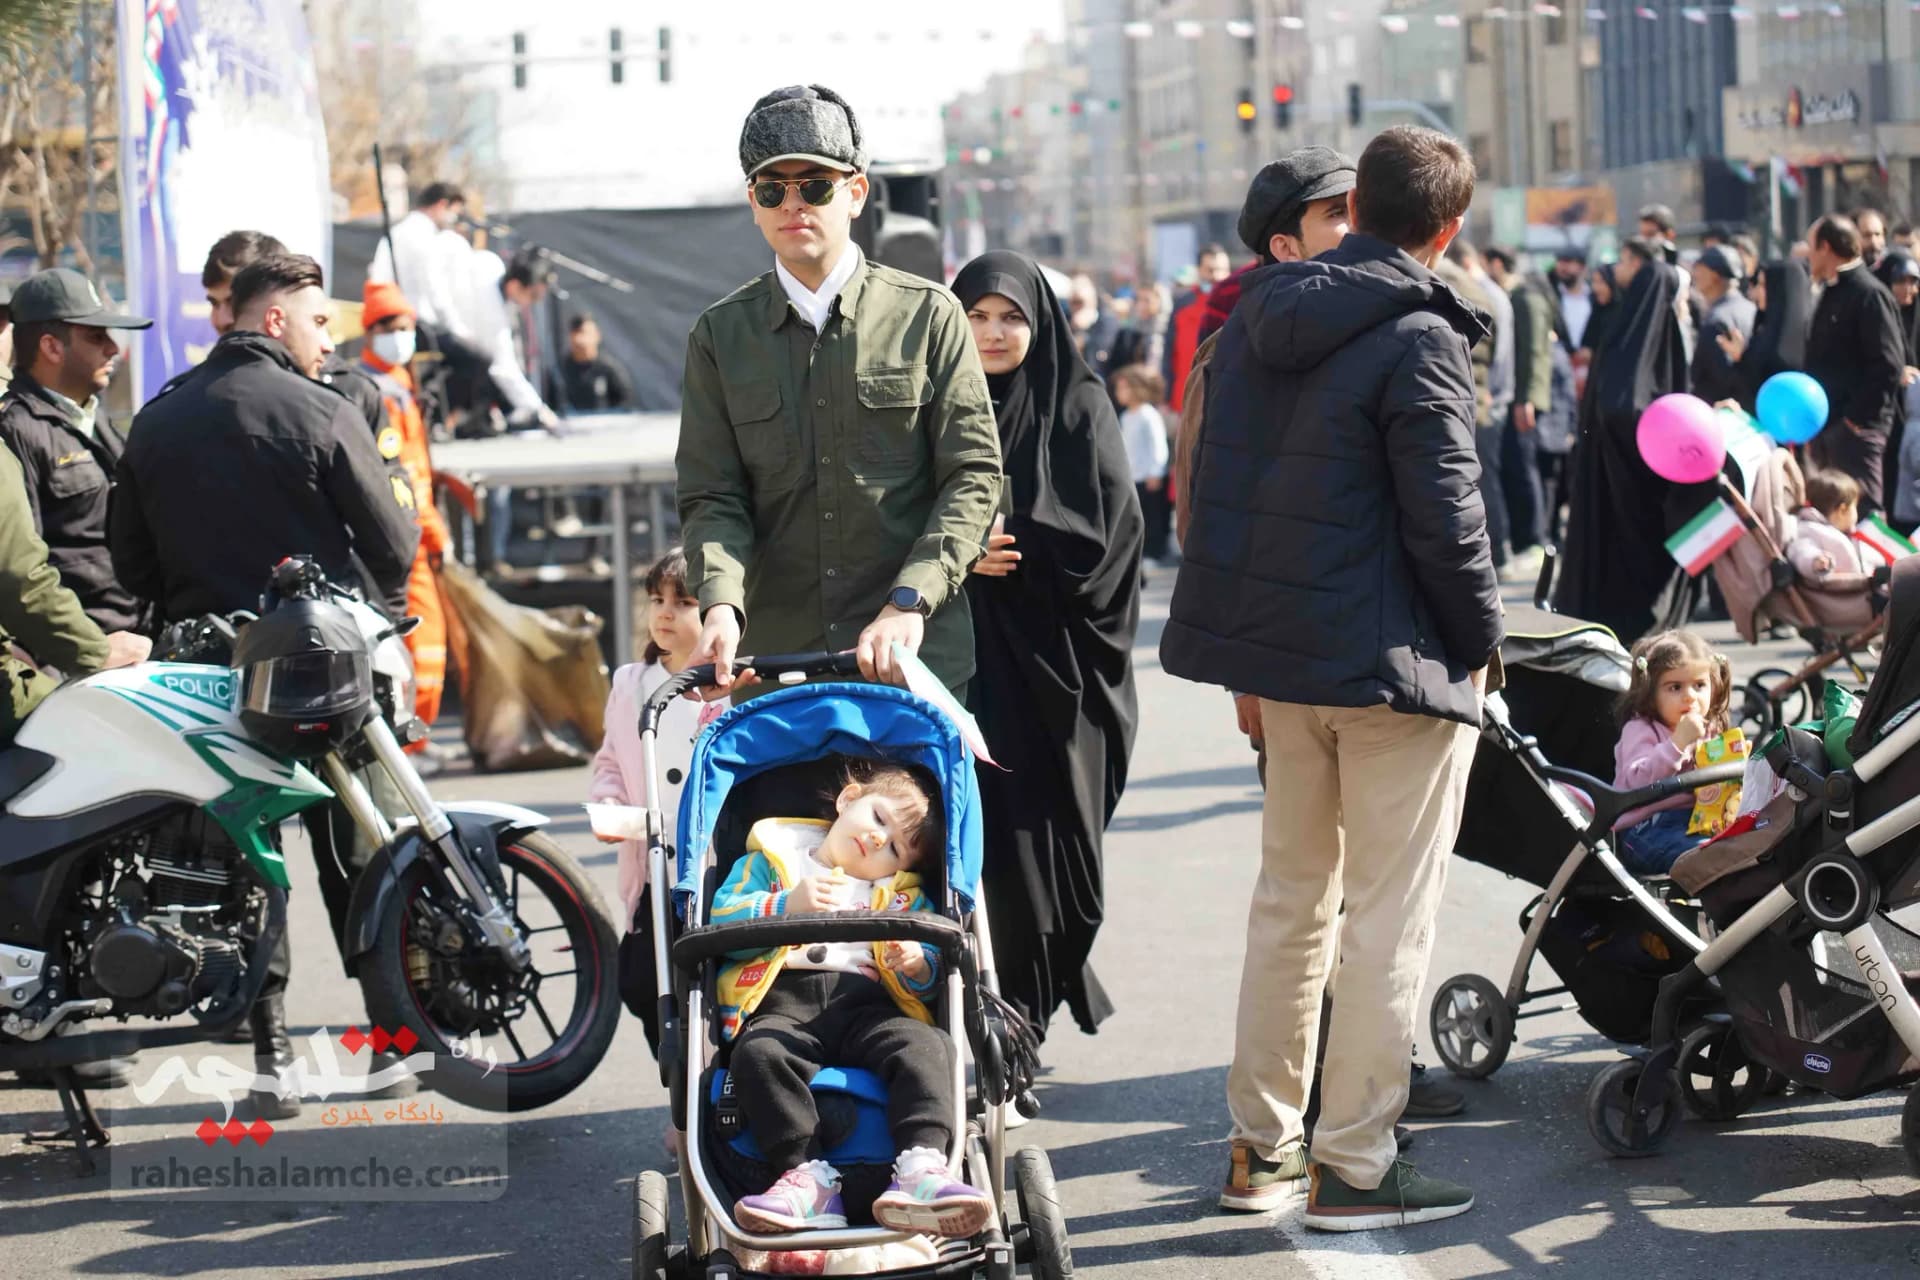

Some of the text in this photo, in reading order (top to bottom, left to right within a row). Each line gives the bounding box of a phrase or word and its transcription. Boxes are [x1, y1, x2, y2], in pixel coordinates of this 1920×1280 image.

[165, 676, 234, 701] POLIC
[1855, 944, 1897, 1012] urban
[1806, 1056, 1829, 1070] chicco
